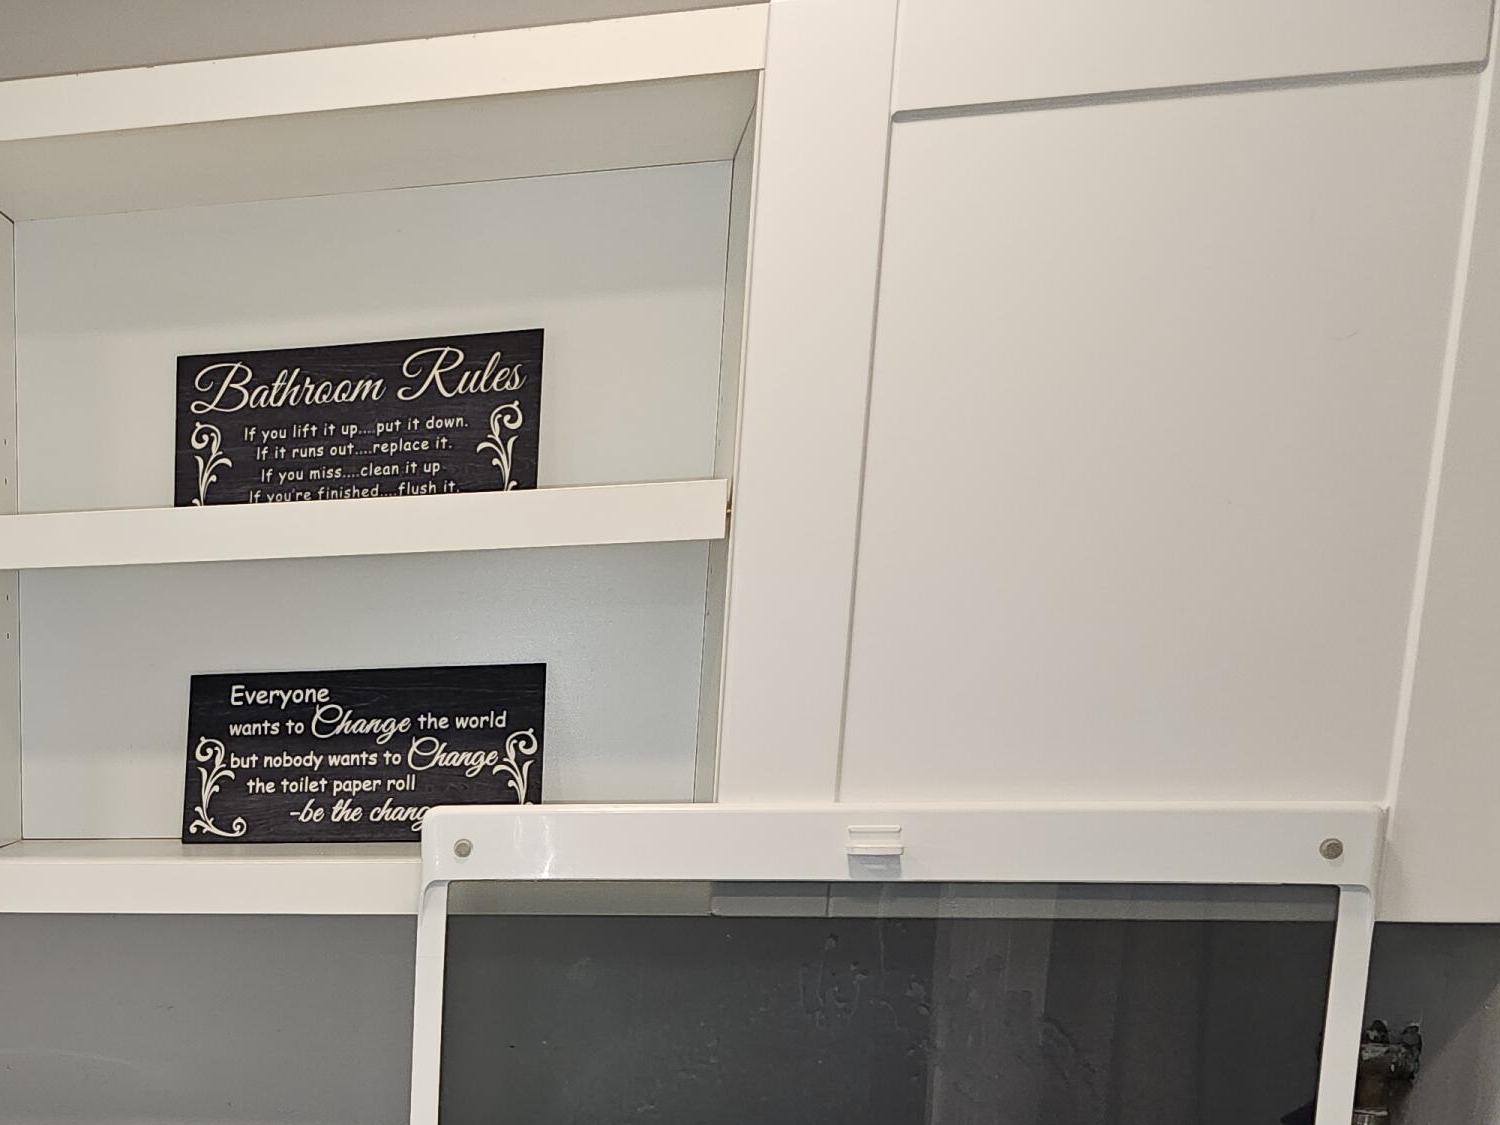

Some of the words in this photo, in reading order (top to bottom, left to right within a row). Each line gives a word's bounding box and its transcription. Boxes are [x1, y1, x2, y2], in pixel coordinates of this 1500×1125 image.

[190, 361, 386, 414] Bathroom
[397, 346, 527, 401] Rules
[244, 427, 257, 441] If
[261, 428, 287, 444] you
[292, 424, 318, 438] lift
[324, 422, 336, 436] it
[407, 418, 420, 430] it
[426, 415, 469, 430] down.
[256, 446, 268, 460] If
[274, 446, 286, 459] it
[292, 446, 324, 459] runs
[435, 436, 453, 450] it.
[261, 468, 274, 482] If
[278, 470, 304, 485] you
[405, 461, 418, 474] it
[423, 462, 441, 476] up
[249, 490, 262, 503] If
[266, 488, 312, 502] you're
[443, 480, 460, 493] it.
[230, 684, 330, 710] Everyone
[229, 719, 280, 736] wants
[286, 718, 305, 736] to
[310, 704, 412, 744] Change
[418, 712, 450, 730] the
[454, 710, 508, 730] world
[230, 752, 259, 770] but
[263, 750, 324, 771] nobody
[328, 750, 378, 768] wants
[382, 749, 402, 766] to
[407, 736, 500, 778] Change
[246, 777, 276, 794] the
[281, 776, 328, 794] toilet
[332, 778, 382, 796] paper
[386, 774, 416, 792] roll
[331, 798, 363, 823] the
[368, 797, 430, 832] chang
